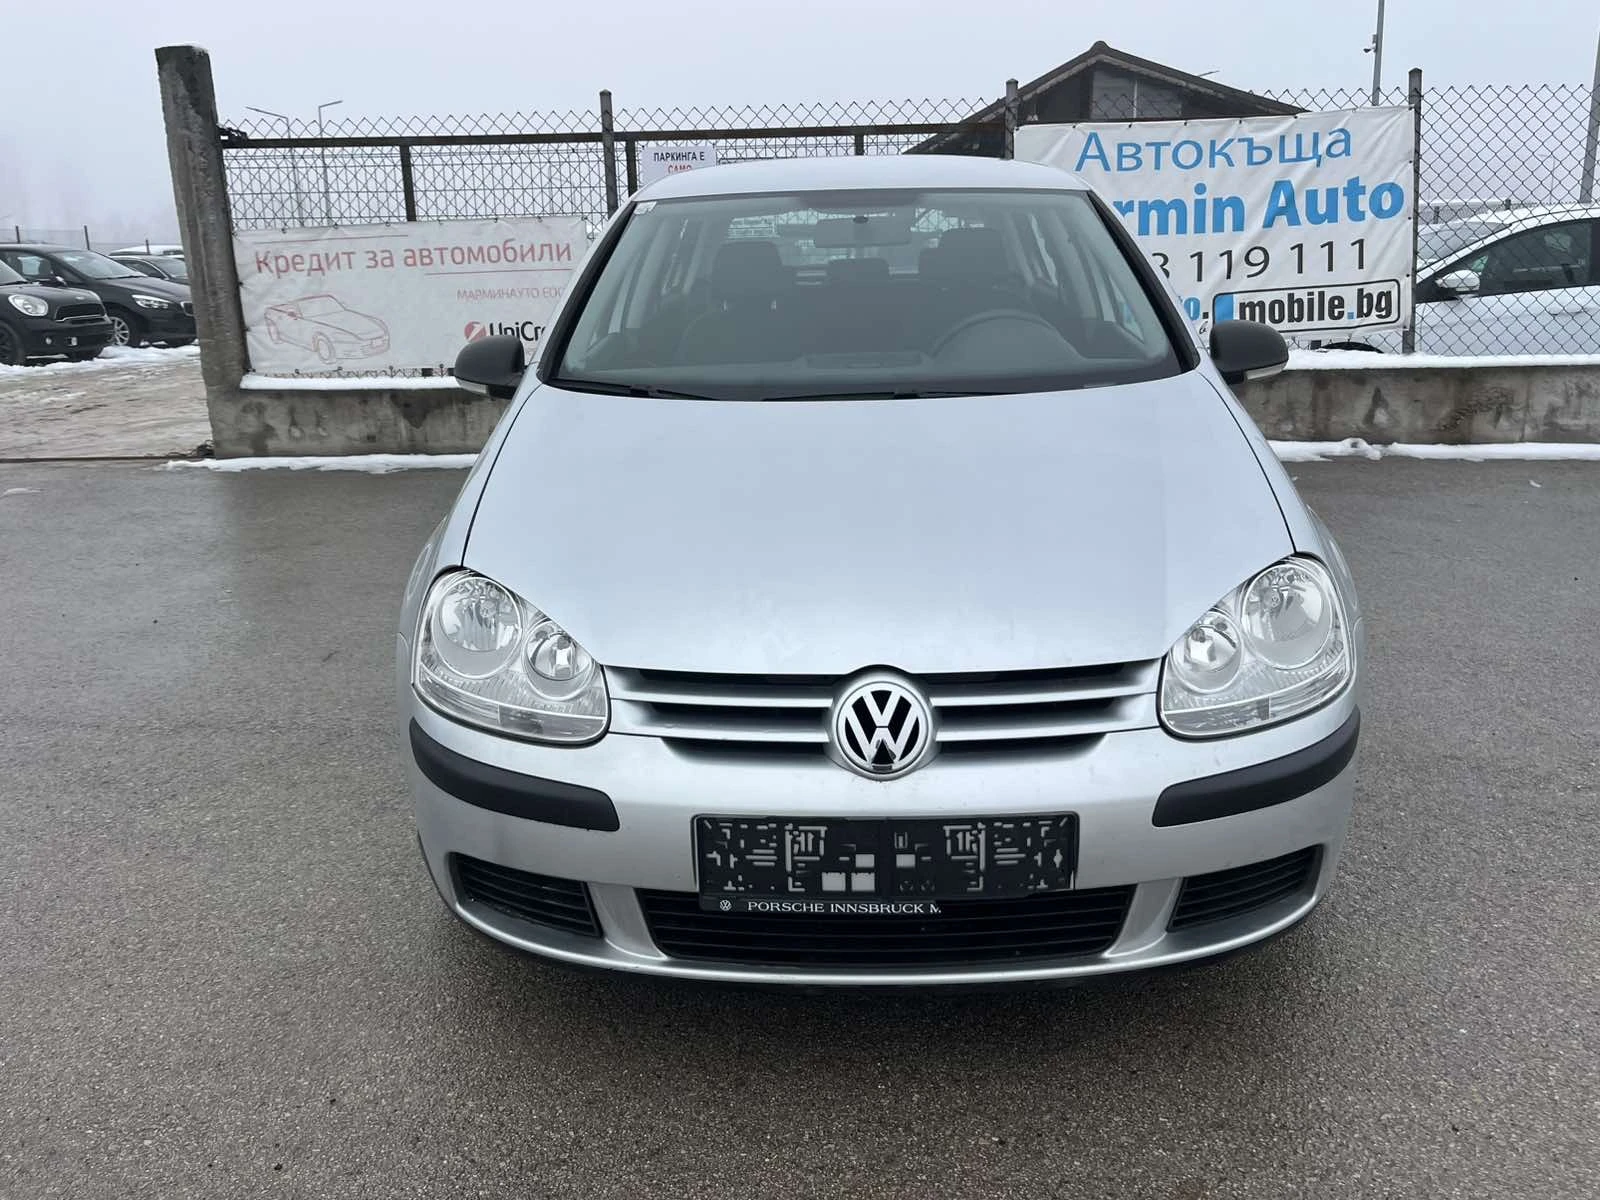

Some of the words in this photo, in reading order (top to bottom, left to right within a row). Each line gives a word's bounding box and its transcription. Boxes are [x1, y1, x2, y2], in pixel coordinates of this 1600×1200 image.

[654, 151, 698, 162] ПАРКИНГА
[1074, 126, 1353, 173] Автокъща
[1111, 182, 1246, 237] rmin
[1263, 175, 1405, 231] Auto
[255, 250, 357, 279] Кредит
[364, 248, 395, 269] за
[403, 238, 574, 268] автомобили
[1190, 244, 1271, 283] 119
[1290, 237, 1367, 276] 111
[1239, 286, 1394, 325] mobile.bg
[489, 321, 546, 342] UniCr
[747, 901, 825, 913] PORSCHE
[830, 903, 924, 914] INNSBRUCK
